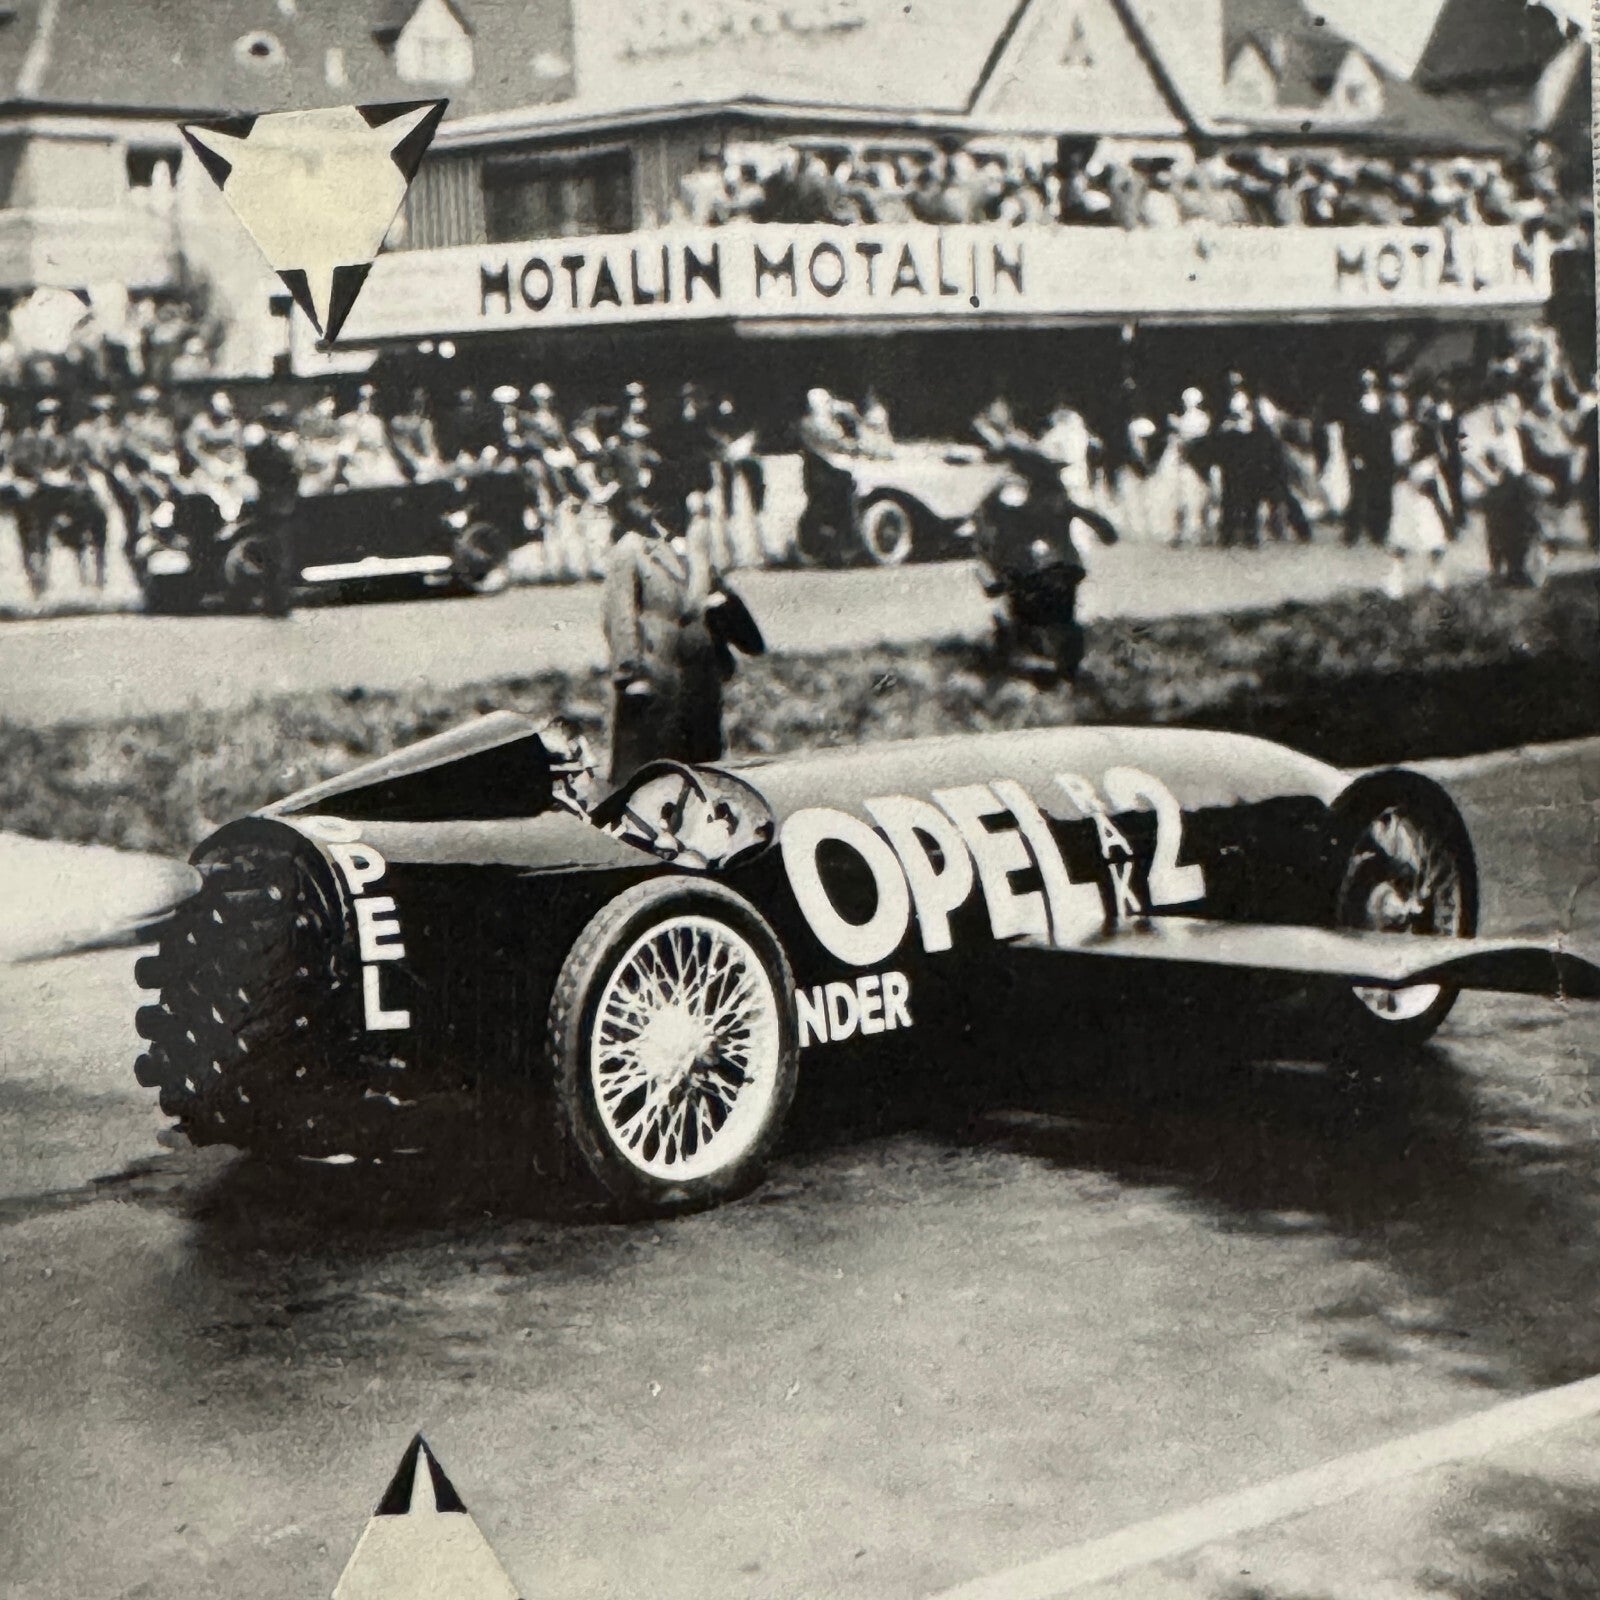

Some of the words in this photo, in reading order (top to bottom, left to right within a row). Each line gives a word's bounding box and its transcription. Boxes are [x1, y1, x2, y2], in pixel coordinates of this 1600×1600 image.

[753, 237, 1023, 298] MOTALIN
[305, 815, 410, 1031] OPEL
[779, 778, 1106, 967] OPEL
[1053, 773, 1142, 926] RAK
[1102, 766, 1207, 907] 2
[795, 971, 913, 1048] NDER
